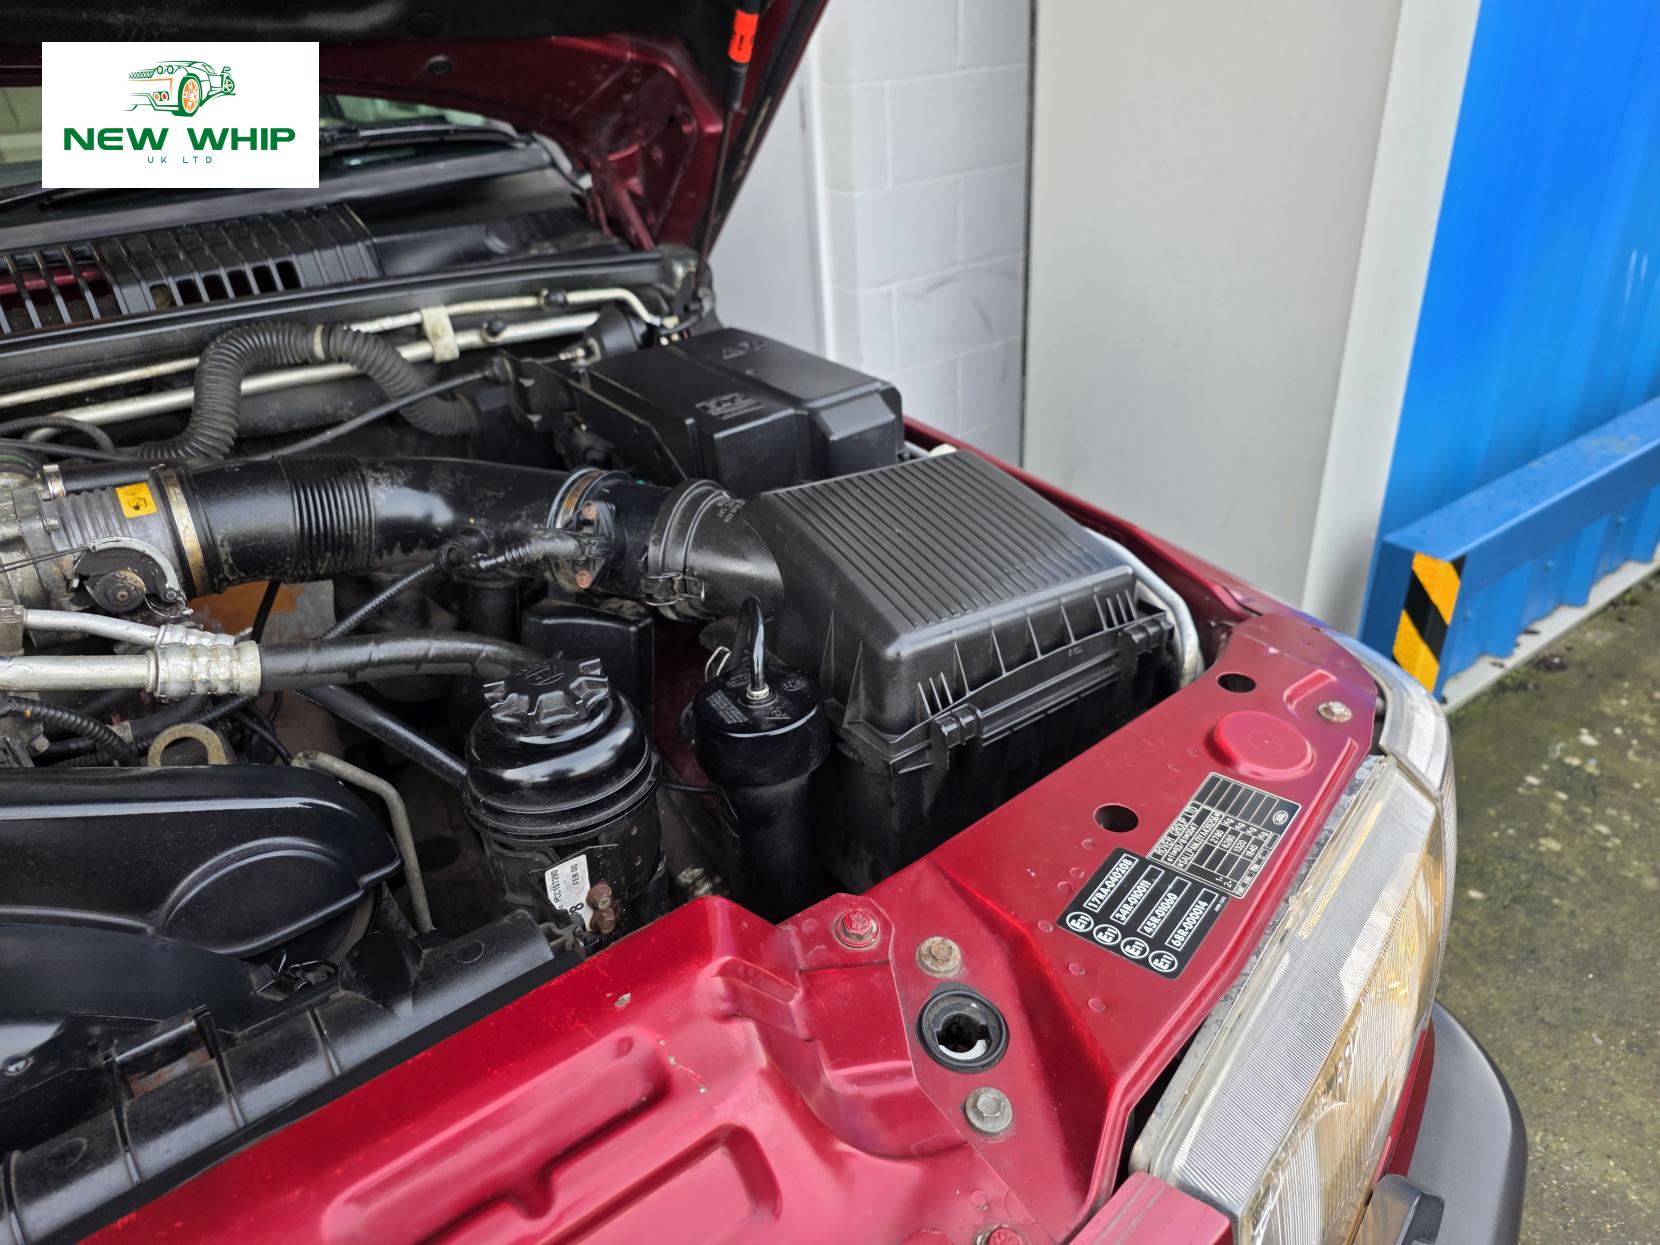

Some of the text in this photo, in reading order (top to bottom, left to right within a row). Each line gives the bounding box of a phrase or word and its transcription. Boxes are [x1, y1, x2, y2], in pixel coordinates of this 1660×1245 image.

[1154, 805, 1198, 856] ROVER GROUP LTD
[1210, 817, 1235, 844] 2780 Kg
[1221, 822, 1246, 849] 6280 Kg
[1234, 840, 1247, 852] 1320
[1245, 826, 1258, 836] Kg
[1245, 844, 1259, 857] 1840
[1256, 831, 1269, 840] Kg
[572, 873, 580, 886] FEB
[1069, 858, 1133, 930] E11 17RA-040208
[1099, 880, 1152, 945] E11 34R-010011
[1124, 892, 1178, 957] E11 45R-01060
[1152, 900, 1209, 971] E11 68R-000014
